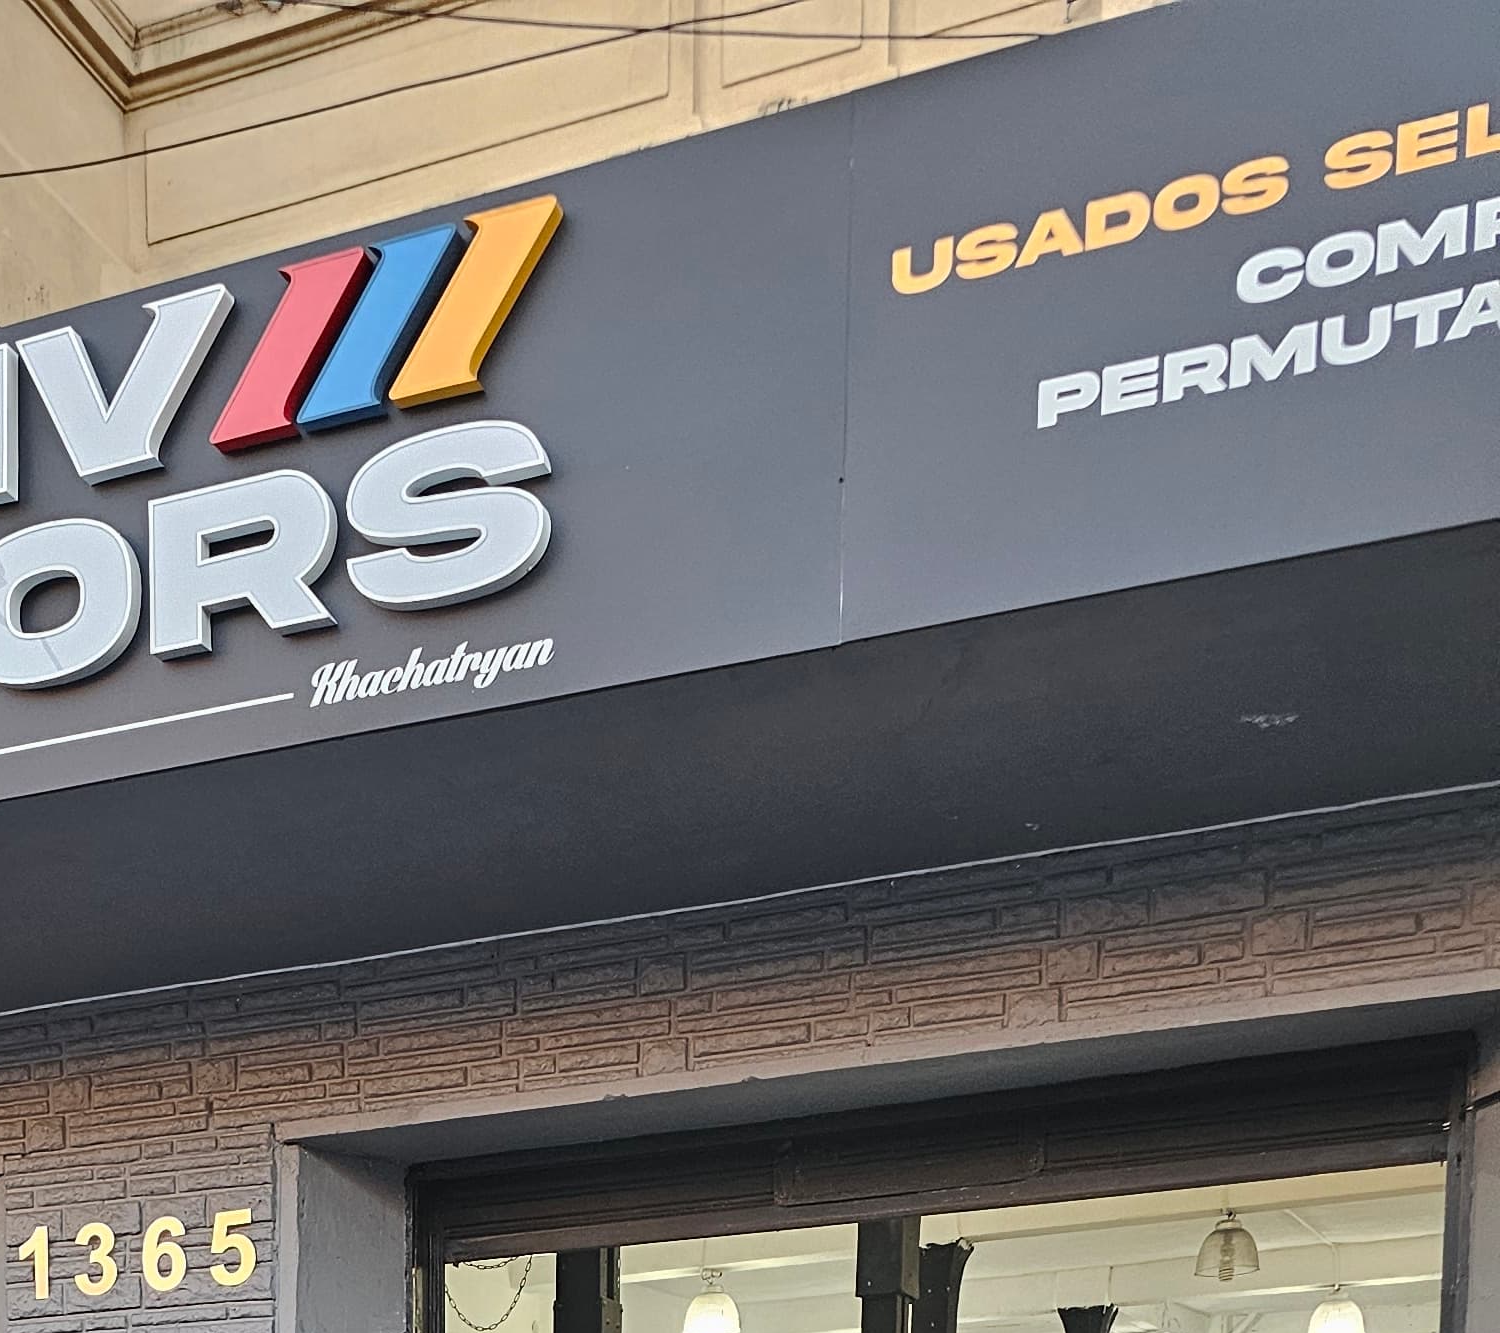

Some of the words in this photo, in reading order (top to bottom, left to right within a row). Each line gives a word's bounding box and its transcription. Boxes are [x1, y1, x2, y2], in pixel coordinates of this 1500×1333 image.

[891, 155, 1289, 294] USADOS
[1324, 102, 1500, 190] SEL
[1037, 279, 1500, 429] PERMUTA
[309, 637, 555, 708] Khachatryan
[18, 1209, 258, 1300] 1365
